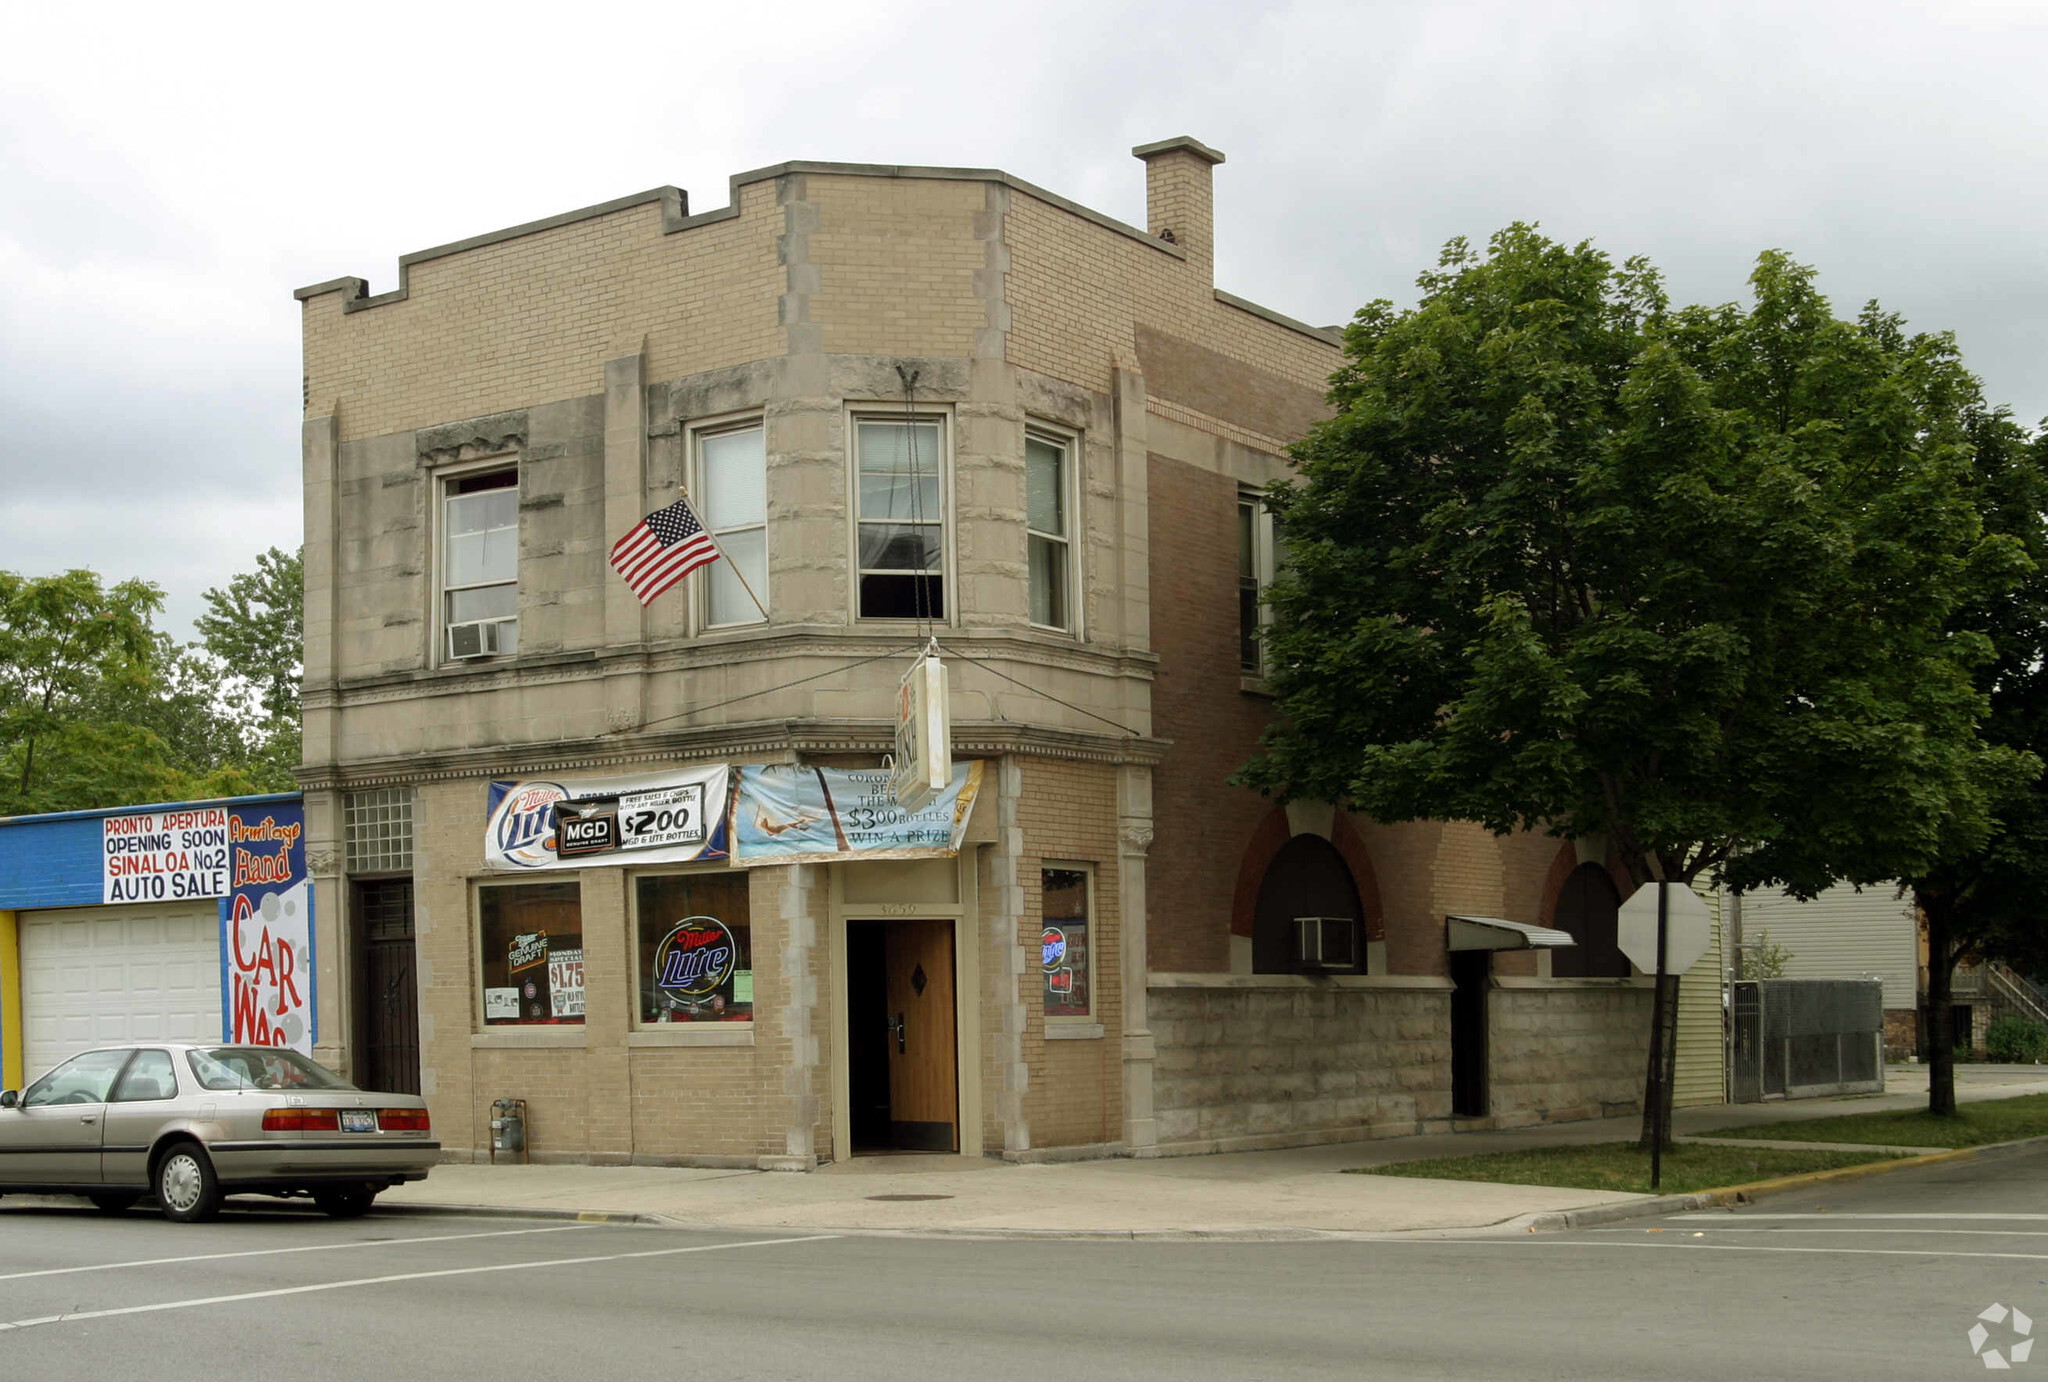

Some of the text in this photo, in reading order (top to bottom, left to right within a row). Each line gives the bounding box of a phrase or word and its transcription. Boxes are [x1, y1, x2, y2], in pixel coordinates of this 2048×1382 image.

[848, 774, 896, 784] CORON
[871, 784, 897, 795] BEE
[858, 795, 885, 807] THE
[105, 809, 226, 836] PRONTO APERTURA
[900, 811, 949, 824] BOTTLES
[106, 829, 225, 854] OPENING SOON
[228, 815, 300, 848] Armitage
[567, 821, 608, 841] MGD
[850, 830, 951, 843] WIN A PRIZE
[109, 852, 190, 876] SINALOA
[233, 847, 292, 888] Hand
[110, 871, 224, 901] AUTO SALE
[232, 893, 302, 1015] CAR
[508, 938, 548, 960] GENUINE
[514, 949, 543, 966] DRAFT
[549, 949, 582, 957] MONDAY
[550, 961, 585, 989] $1.75
[658, 947, 729, 988] Lite
